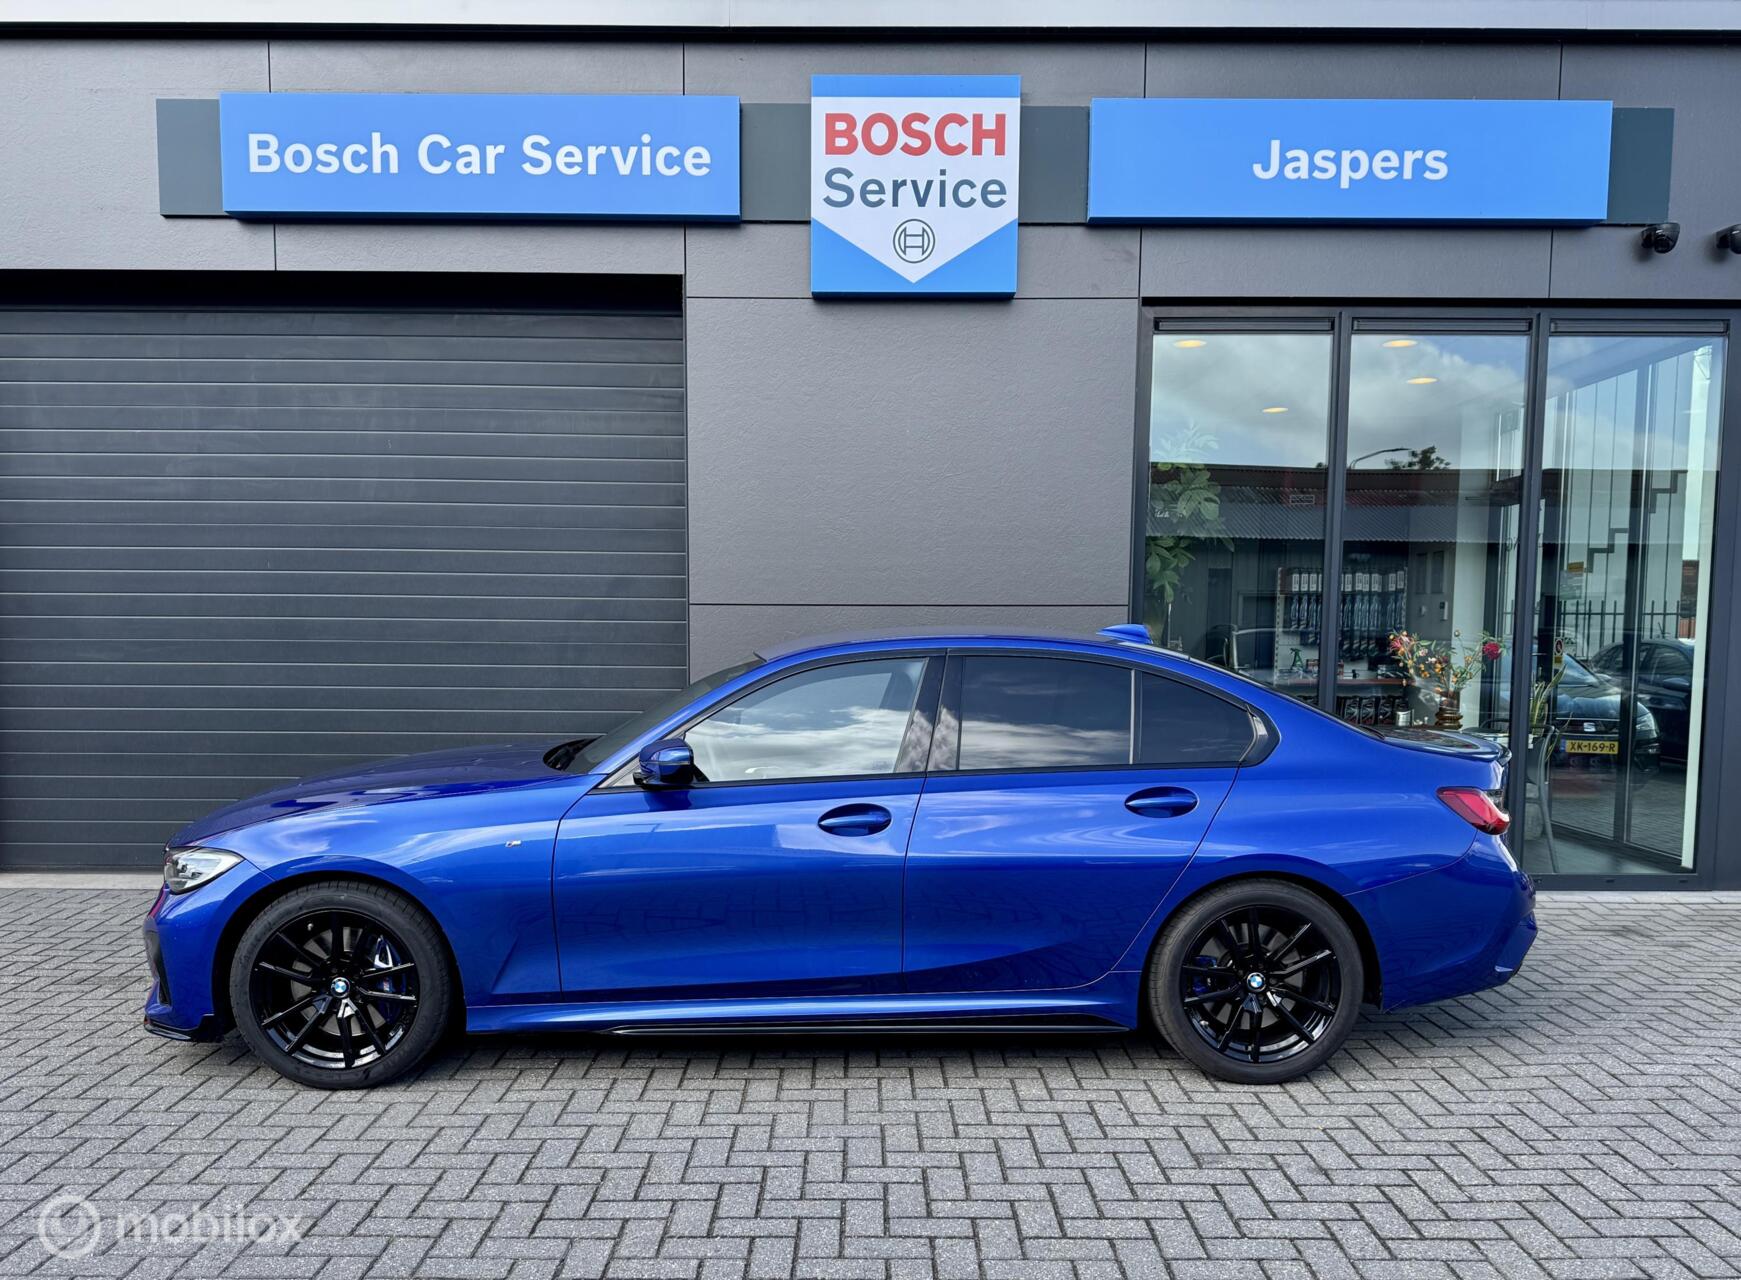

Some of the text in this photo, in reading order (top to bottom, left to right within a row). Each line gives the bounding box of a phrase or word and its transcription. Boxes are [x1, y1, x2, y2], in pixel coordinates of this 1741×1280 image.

[248, 132, 711, 176] Bosch Car Service
[825, 112, 1006, 156] BOSCH
[1252, 139, 1448, 189] Jaspers
[823, 167, 1007, 208] Service
[1570, 741, 1616, 753] XK-169-R
